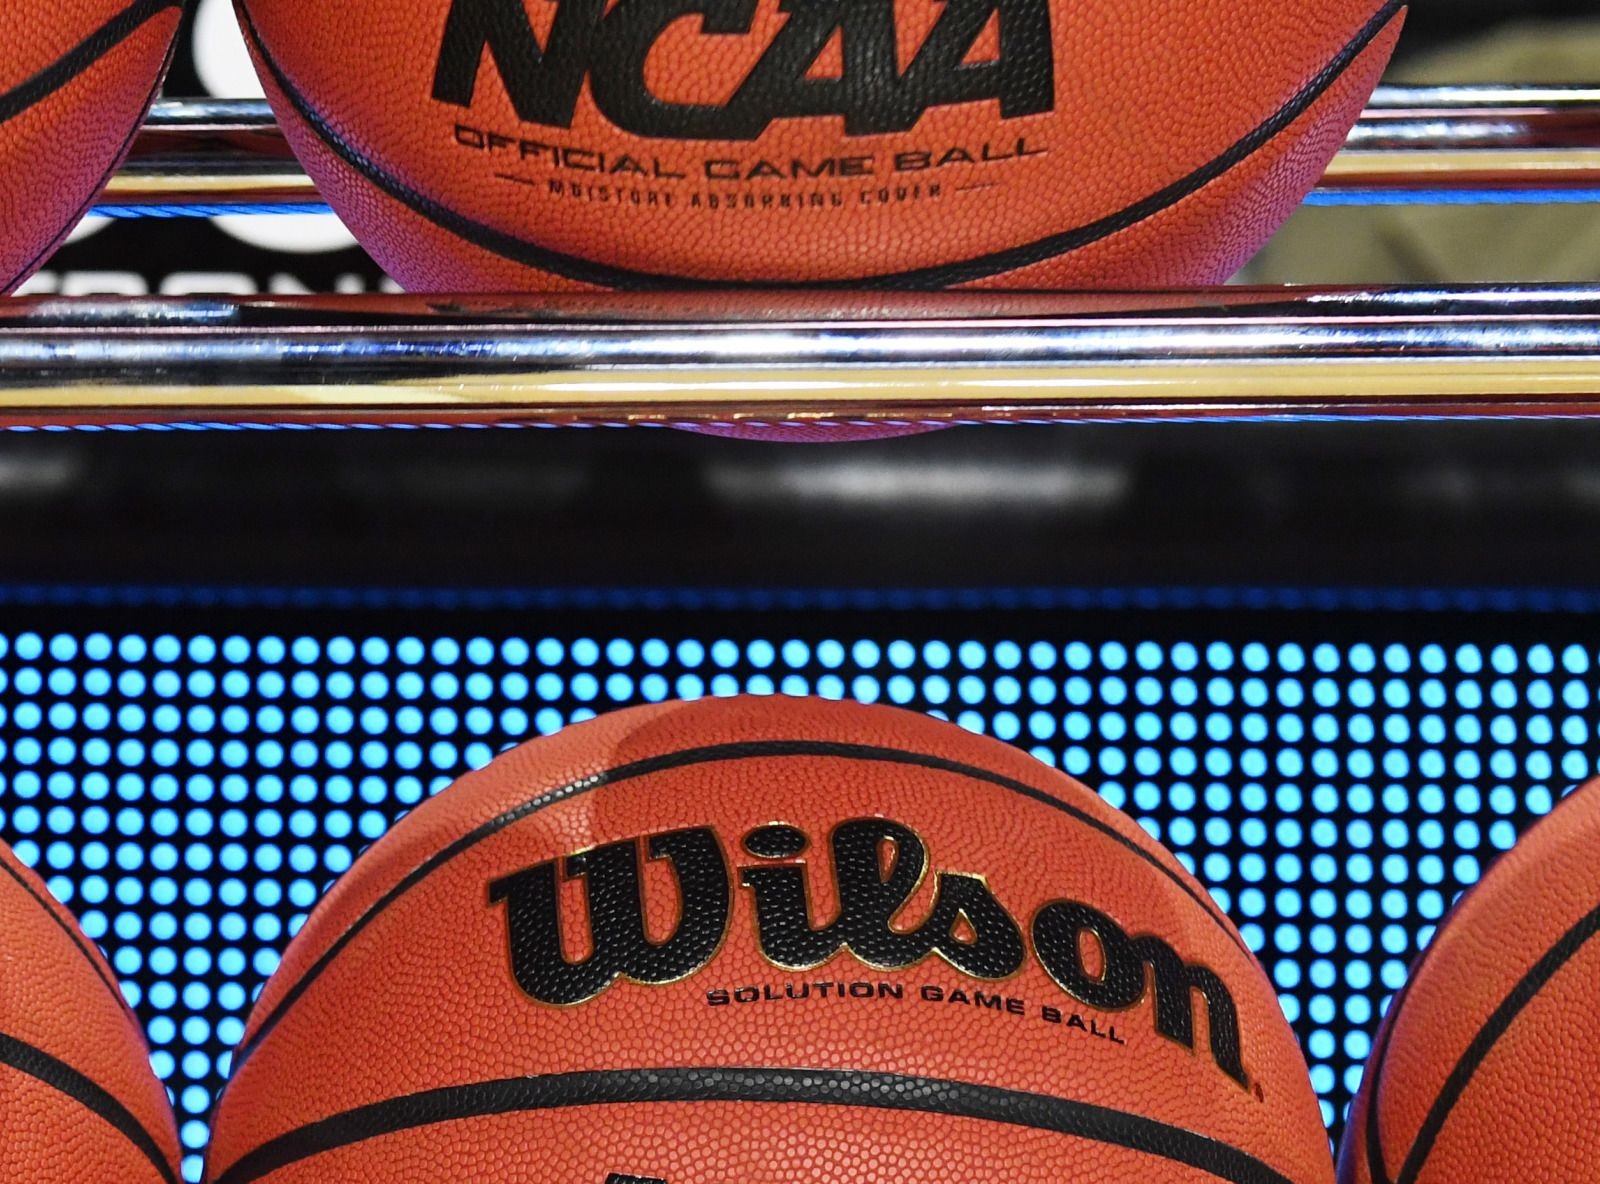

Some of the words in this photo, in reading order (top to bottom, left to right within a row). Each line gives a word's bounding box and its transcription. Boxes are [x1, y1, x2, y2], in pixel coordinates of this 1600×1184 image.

[431, 0, 1056, 140] NCAA
[453, 123, 686, 180] OFFICIAL
[703, 155, 876, 181] GAME
[893, 137, 1050, 171] BALL
[487, 815, 1254, 1095] Wilson
[706, 981, 905, 1007] SOLUTION
[920, 985, 1025, 1015] GAME
[1040, 1005, 1126, 1045] BALL
